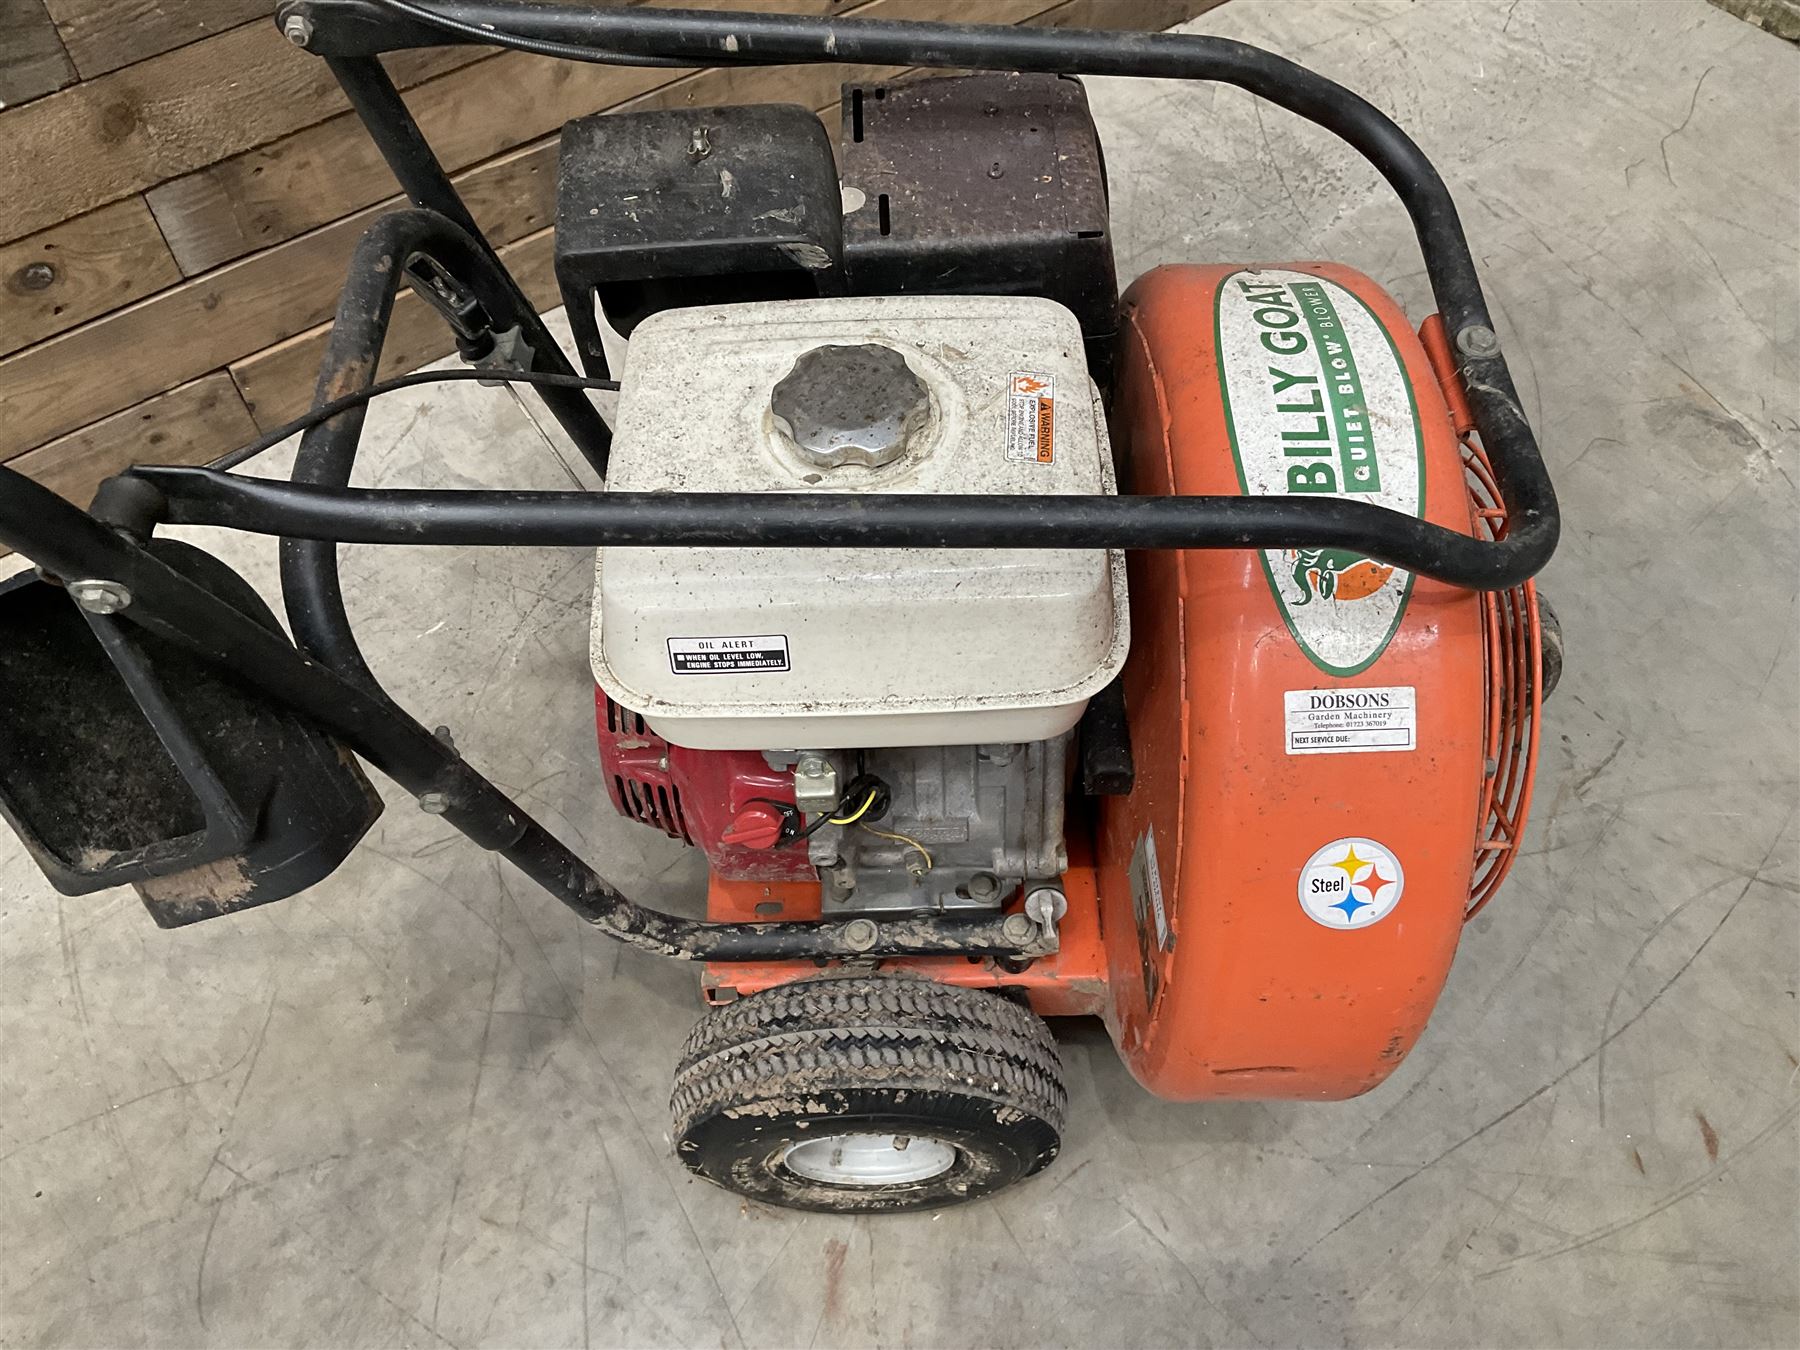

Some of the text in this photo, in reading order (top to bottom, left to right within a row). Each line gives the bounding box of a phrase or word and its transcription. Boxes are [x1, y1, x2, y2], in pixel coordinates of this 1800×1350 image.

[1302, 287, 1334, 329] BLOWER
[1237, 280, 1338, 493] BILLY GOAT
[1028, 399, 1036, 432] EXPLOSIVE
[1028, 433, 1036, 449] FUEL
[1040, 412, 1051, 458] WARNING
[1343, 408, 1371, 481] QUIET
[698, 640, 754, 649] OIL ALERT
[685, 653, 707, 661] WHEN
[723, 652, 743, 660] LEVEL
[746, 652, 764, 660] LOW,
[713, 660, 735, 668] STOPS
[737, 659, 784, 668] IMMEDIATELY.
[1310, 693, 1390, 709] DOBSONS
[1308, 711, 1393, 721] Garden Machinery
[1313, 722, 1344, 730] Telephone:
[1294, 736, 1309, 744] NEXT
[1310, 735, 1334, 744] SERVICE
[785, 828, 795, 836] ON
[1311, 876, 1344, 893] Steel
